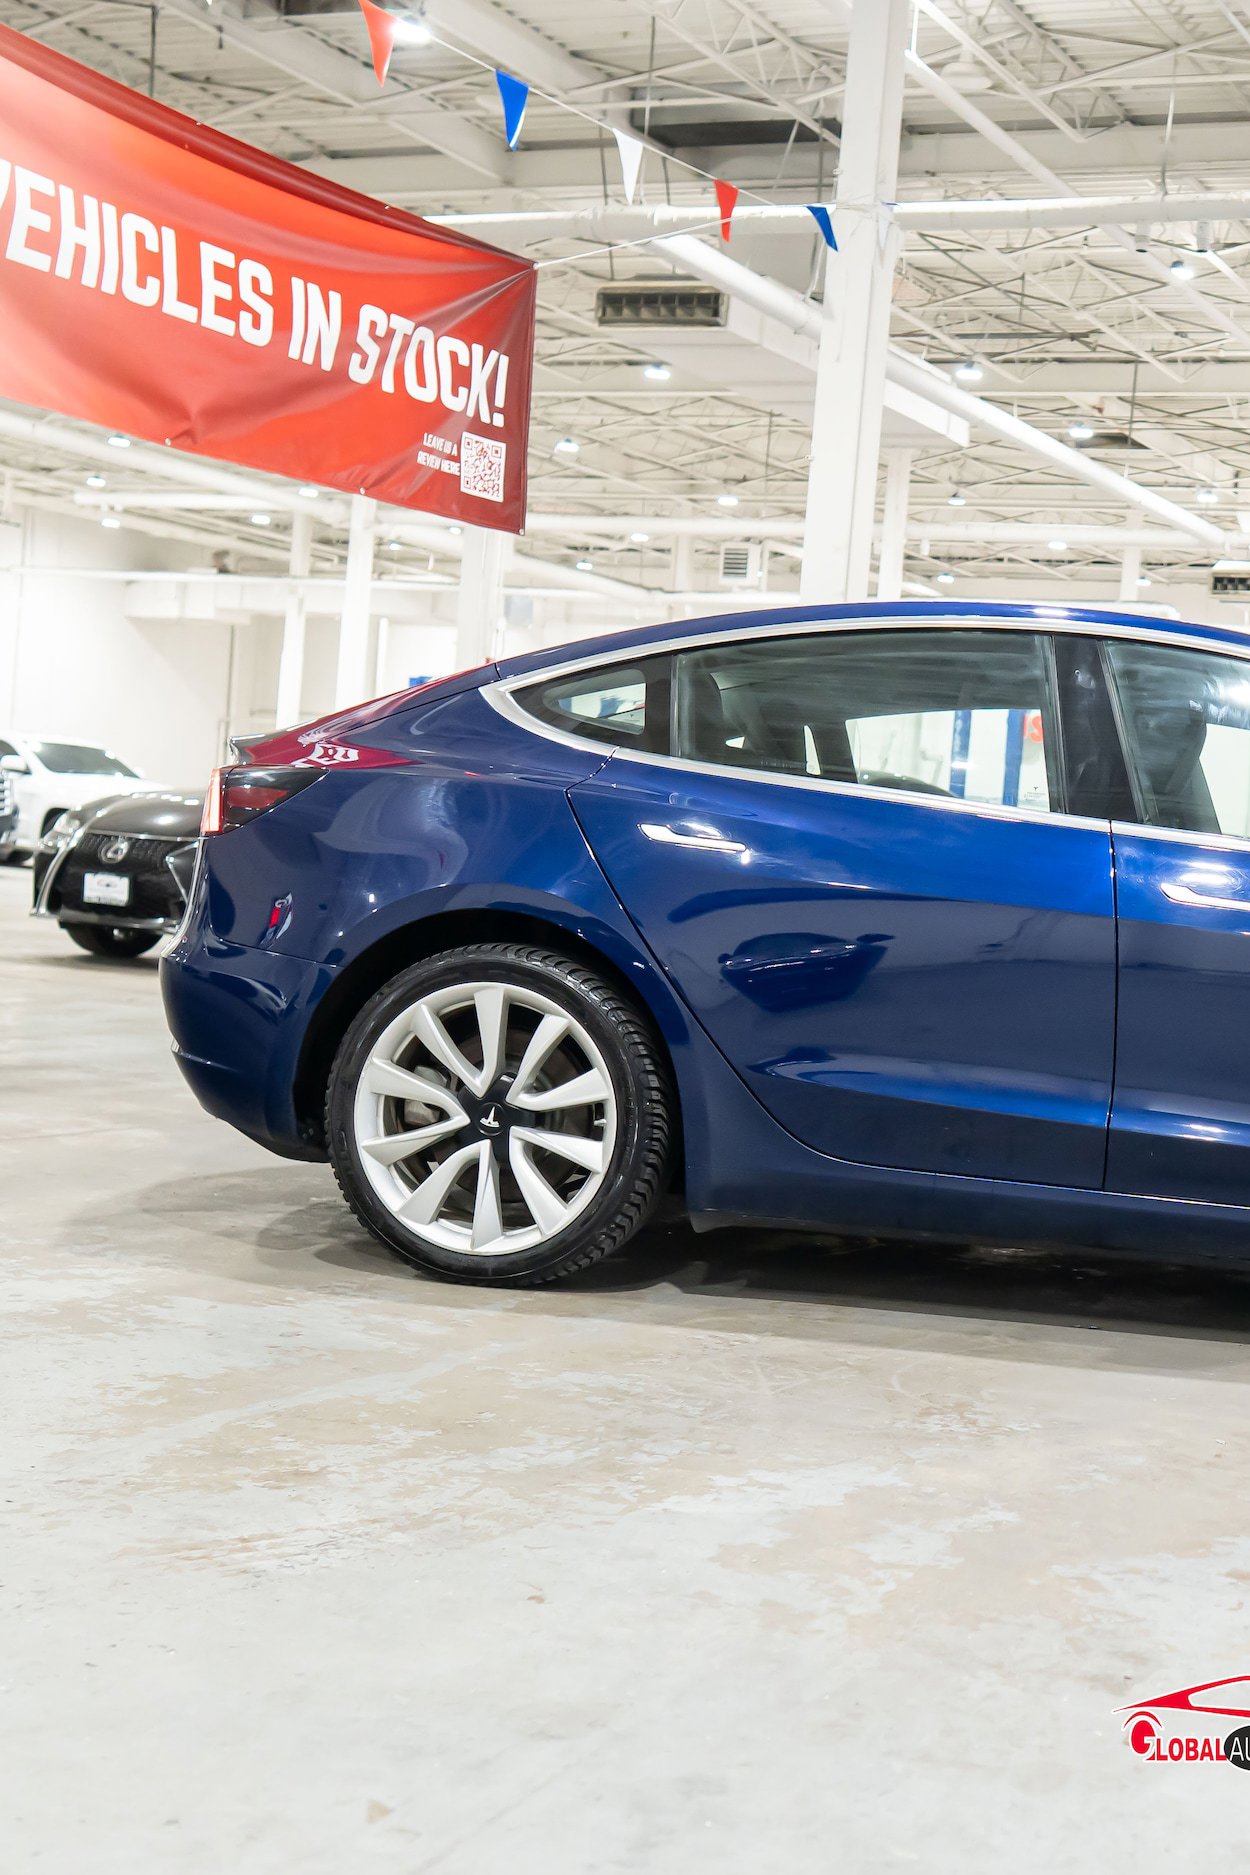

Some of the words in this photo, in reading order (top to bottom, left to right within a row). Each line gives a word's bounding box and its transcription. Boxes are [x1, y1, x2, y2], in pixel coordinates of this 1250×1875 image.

[288, 276, 341, 371] IN
[348, 304, 510, 427] STOCK!
[423, 432, 444, 451] LEAVE
[451, 443, 458, 456] A
[417, 450, 441, 470] REVIEW
[441, 459, 460, 476] HERE
